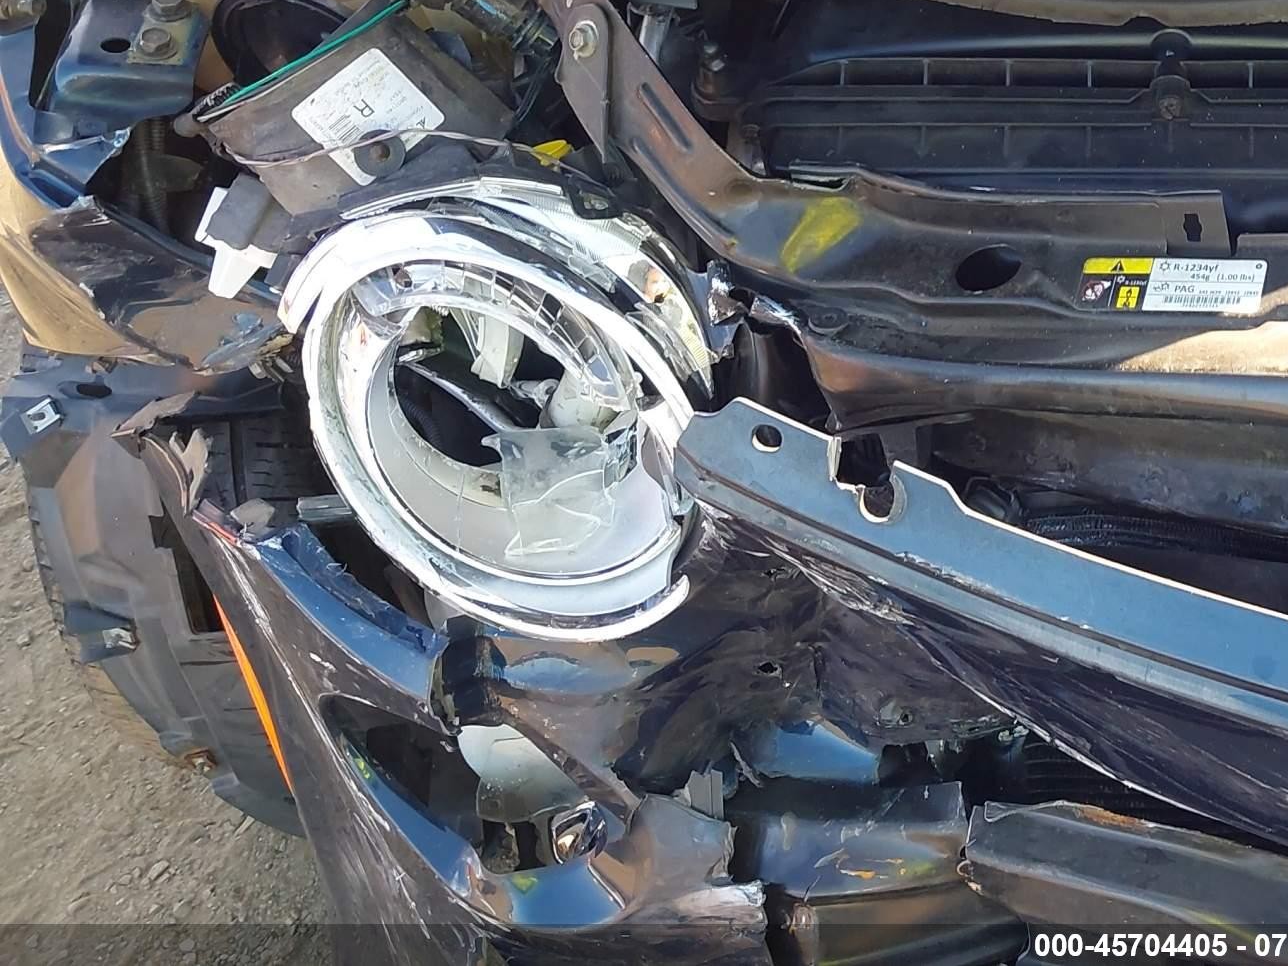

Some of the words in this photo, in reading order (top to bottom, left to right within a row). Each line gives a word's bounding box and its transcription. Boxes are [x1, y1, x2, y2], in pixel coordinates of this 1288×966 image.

[352, 98, 377, 119] R
[1173, 263, 1219, 274] R-1234yf
[1190, 273, 1210, 282] 454g
[1216, 273, 1238, 282] (1.00
[1239, 273, 1255, 282] lbs)
[1174, 285, 1195, 293] PAG
